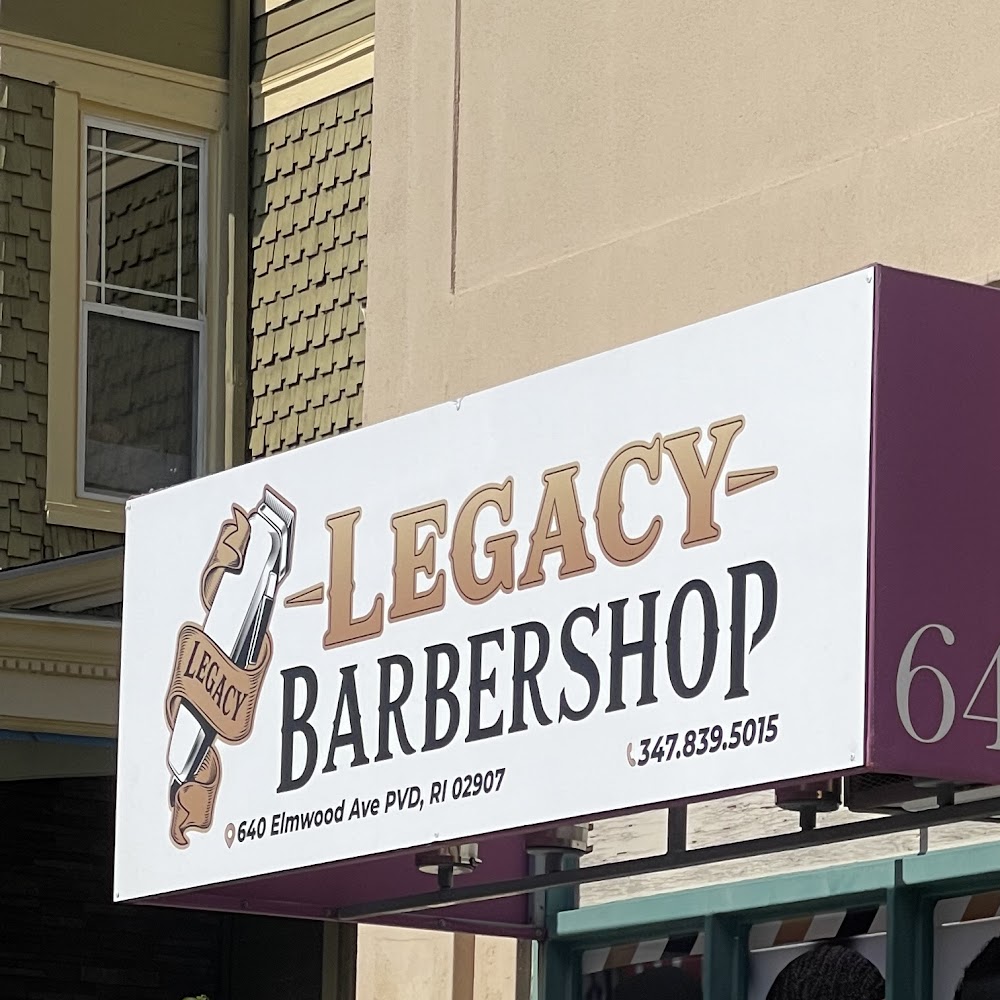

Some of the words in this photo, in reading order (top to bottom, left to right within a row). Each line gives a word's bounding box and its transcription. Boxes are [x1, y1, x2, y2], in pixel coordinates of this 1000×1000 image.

[321, 415, 746, 651] LEGACY
[183, 640, 249, 722] LEGACY
[275, 559, 779, 794] BARBERSHOP
[637, 713, 780, 767] 347.839.5015
[237, 816, 267, 843] 640
[270, 798, 346, 837] Elmwood
[347, 797, 381, 821] Ave
[384, 785, 425, 814] PVD,
[429, 779, 449, 805] RI
[451, 767, 507, 801] 02907
